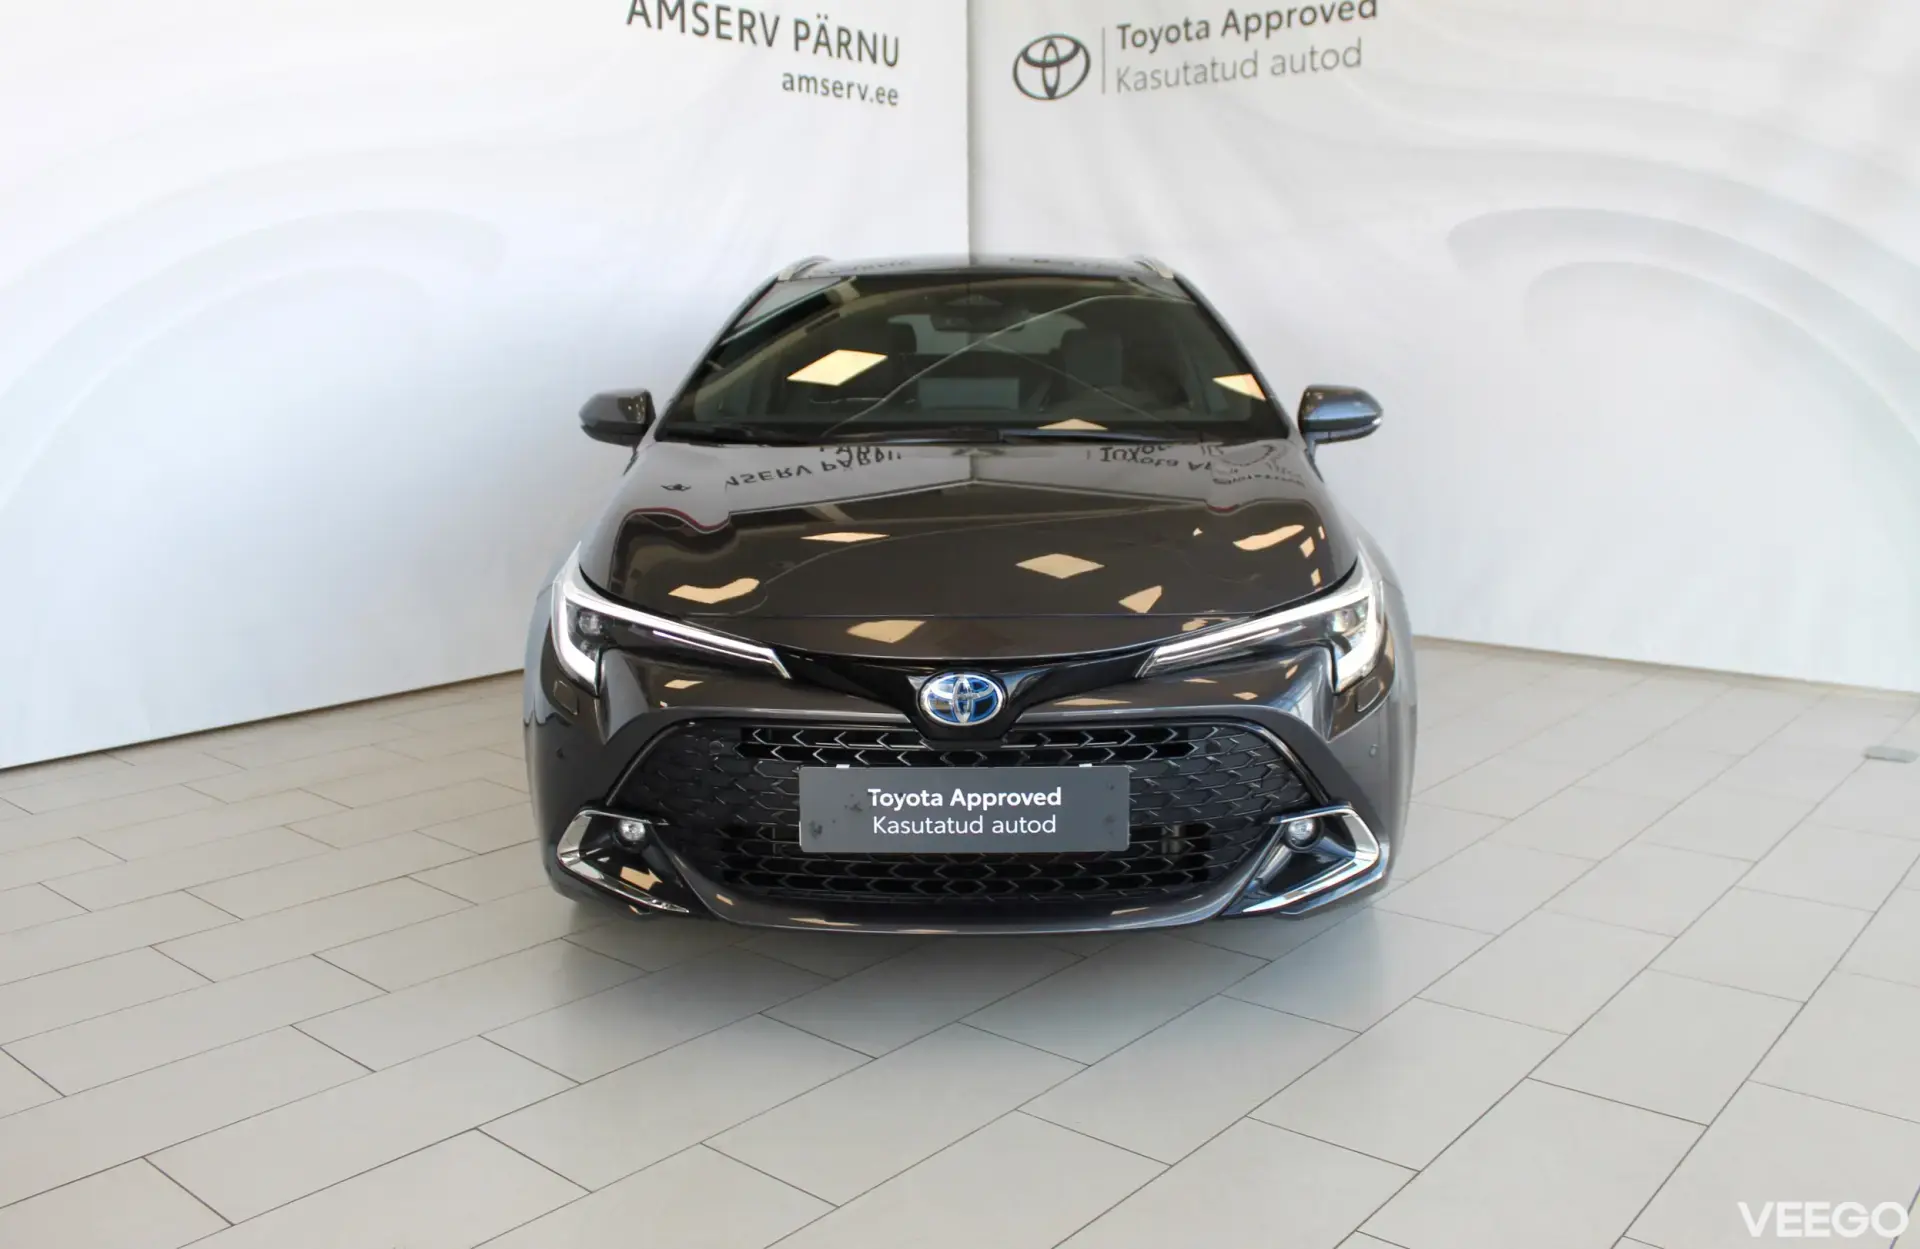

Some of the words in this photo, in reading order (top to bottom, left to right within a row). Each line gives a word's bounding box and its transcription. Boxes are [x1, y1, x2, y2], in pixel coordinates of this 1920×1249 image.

[625, 0, 781, 48] AMSERV
[793, 13, 899, 68] PÄRNU
[1116, 17, 1210, 53] Toyota
[1221, 0, 1378, 41] Approved
[1116, 50, 1259, 94] Kasutatud
[1270, 36, 1363, 77] autod
[782, 72, 899, 106] amserv.ee
[867, 788, 943, 811] Toyota
[949, 787, 1062, 811] Approved
[873, 815, 983, 835] Kasutatud
[991, 814, 1057, 835] autod
